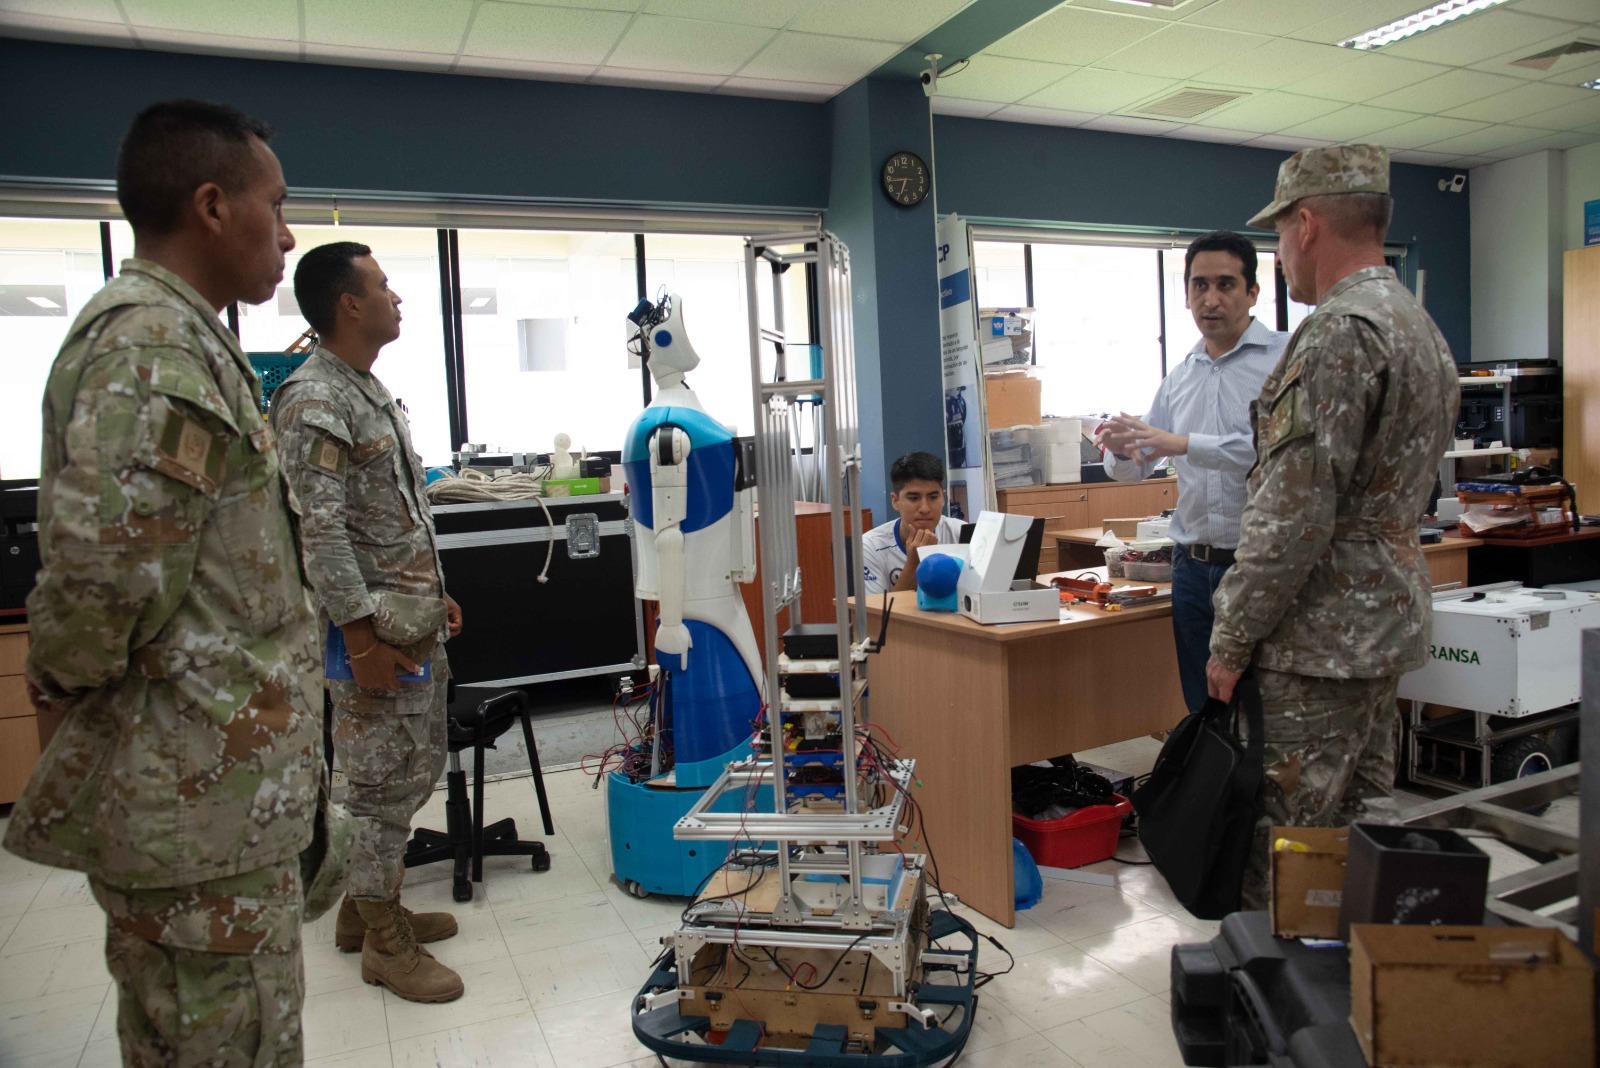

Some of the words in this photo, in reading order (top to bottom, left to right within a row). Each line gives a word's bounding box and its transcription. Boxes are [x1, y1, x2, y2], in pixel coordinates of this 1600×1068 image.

[901, 156, 908, 165] 12
[887, 166, 895, 174] 10
[938, 244, 950, 263] CP
[1430, 645, 1480, 665] RANSA
